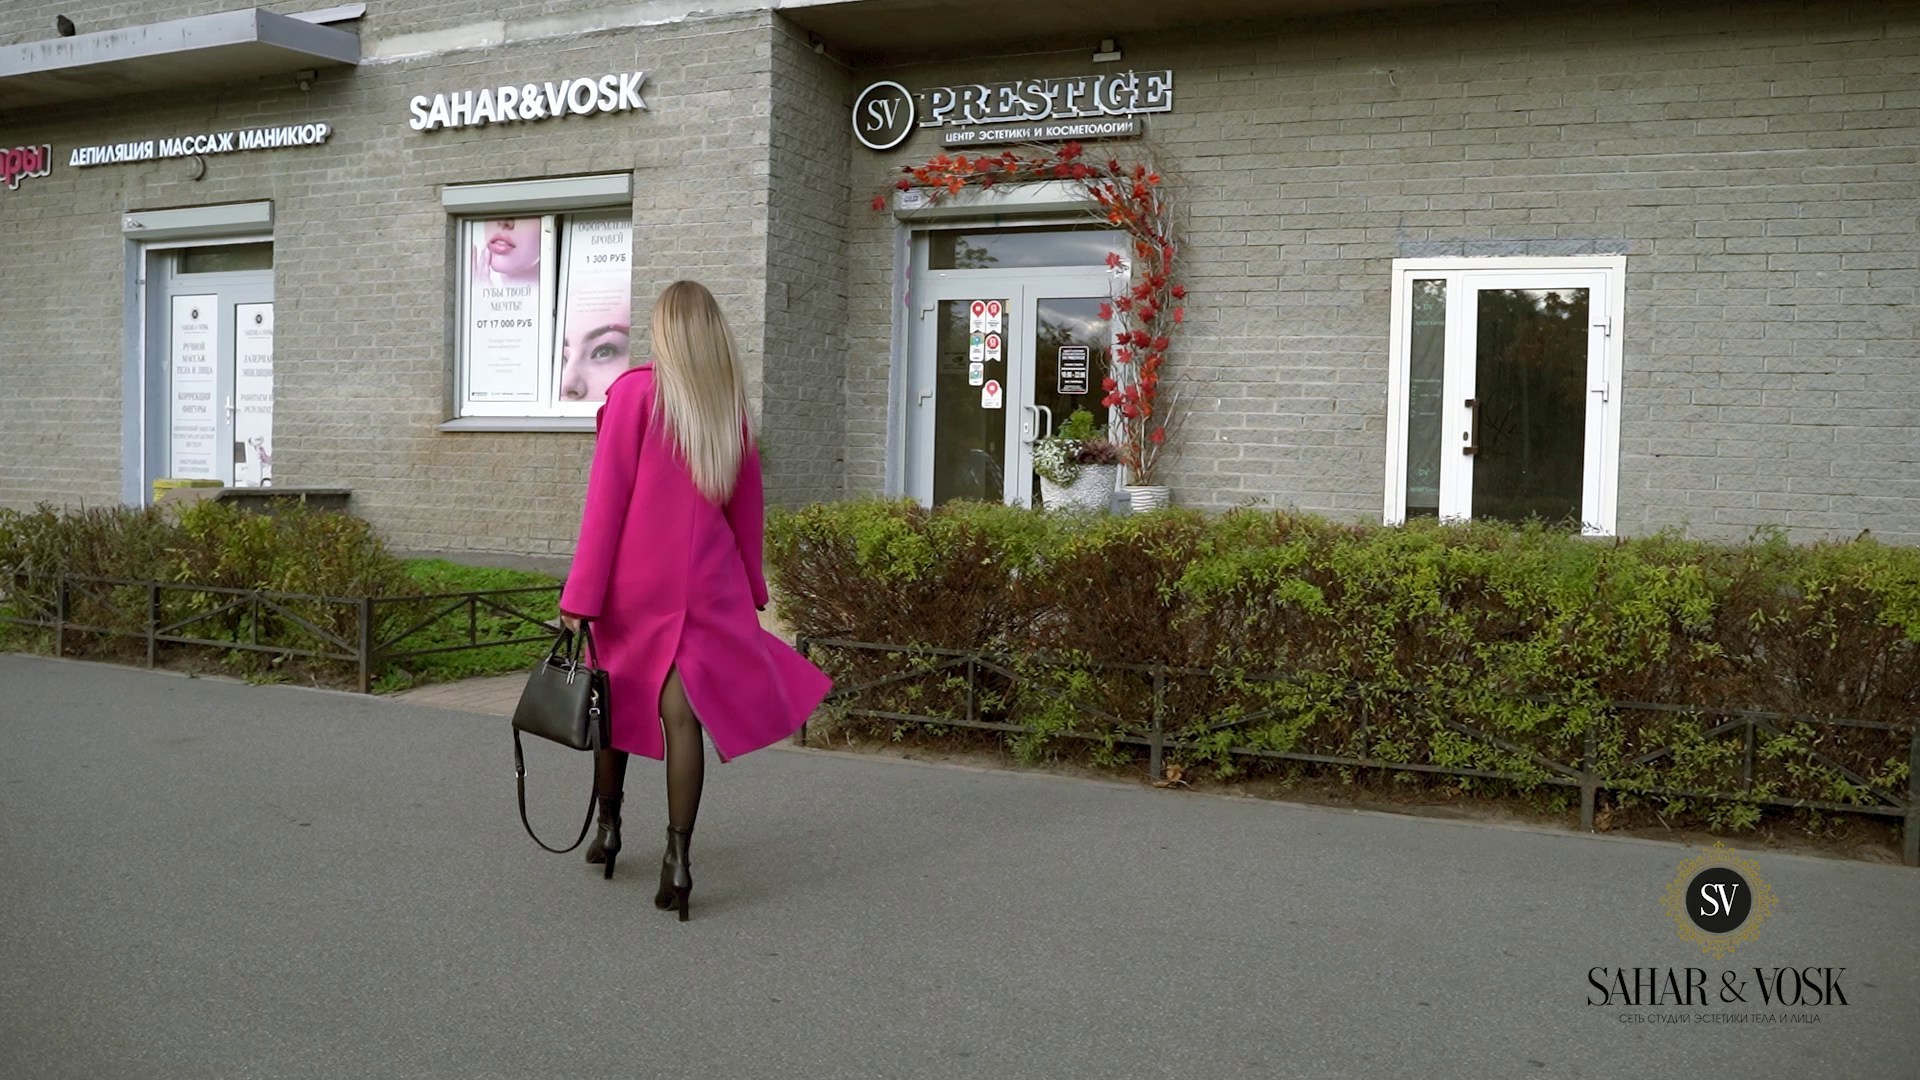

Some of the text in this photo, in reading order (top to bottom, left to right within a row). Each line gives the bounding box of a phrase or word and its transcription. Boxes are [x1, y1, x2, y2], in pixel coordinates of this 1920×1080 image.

[409, 71, 645, 131] SAHAR&VOSK
[919, 70, 1172, 128] PRESTIGE
[867, 98, 900, 131] SV
[945, 122, 1133, 143] ЦЕНТР ЭСТЕТИКИ И КОСМЕТОЛОГИИ
[69, 123, 328, 167] ДЕПИЛЯЦИЯ МАССАЖ МАНИКЮР
[591, 232, 624, 245] БРОВЕЙ
[592, 254, 608, 263] 300
[609, 253, 627, 263] РУБ
[482, 284, 532, 298] ГУБЫ ТВОЕЙ
[476, 318, 533, 328] ОТ 17 000 РУБ
